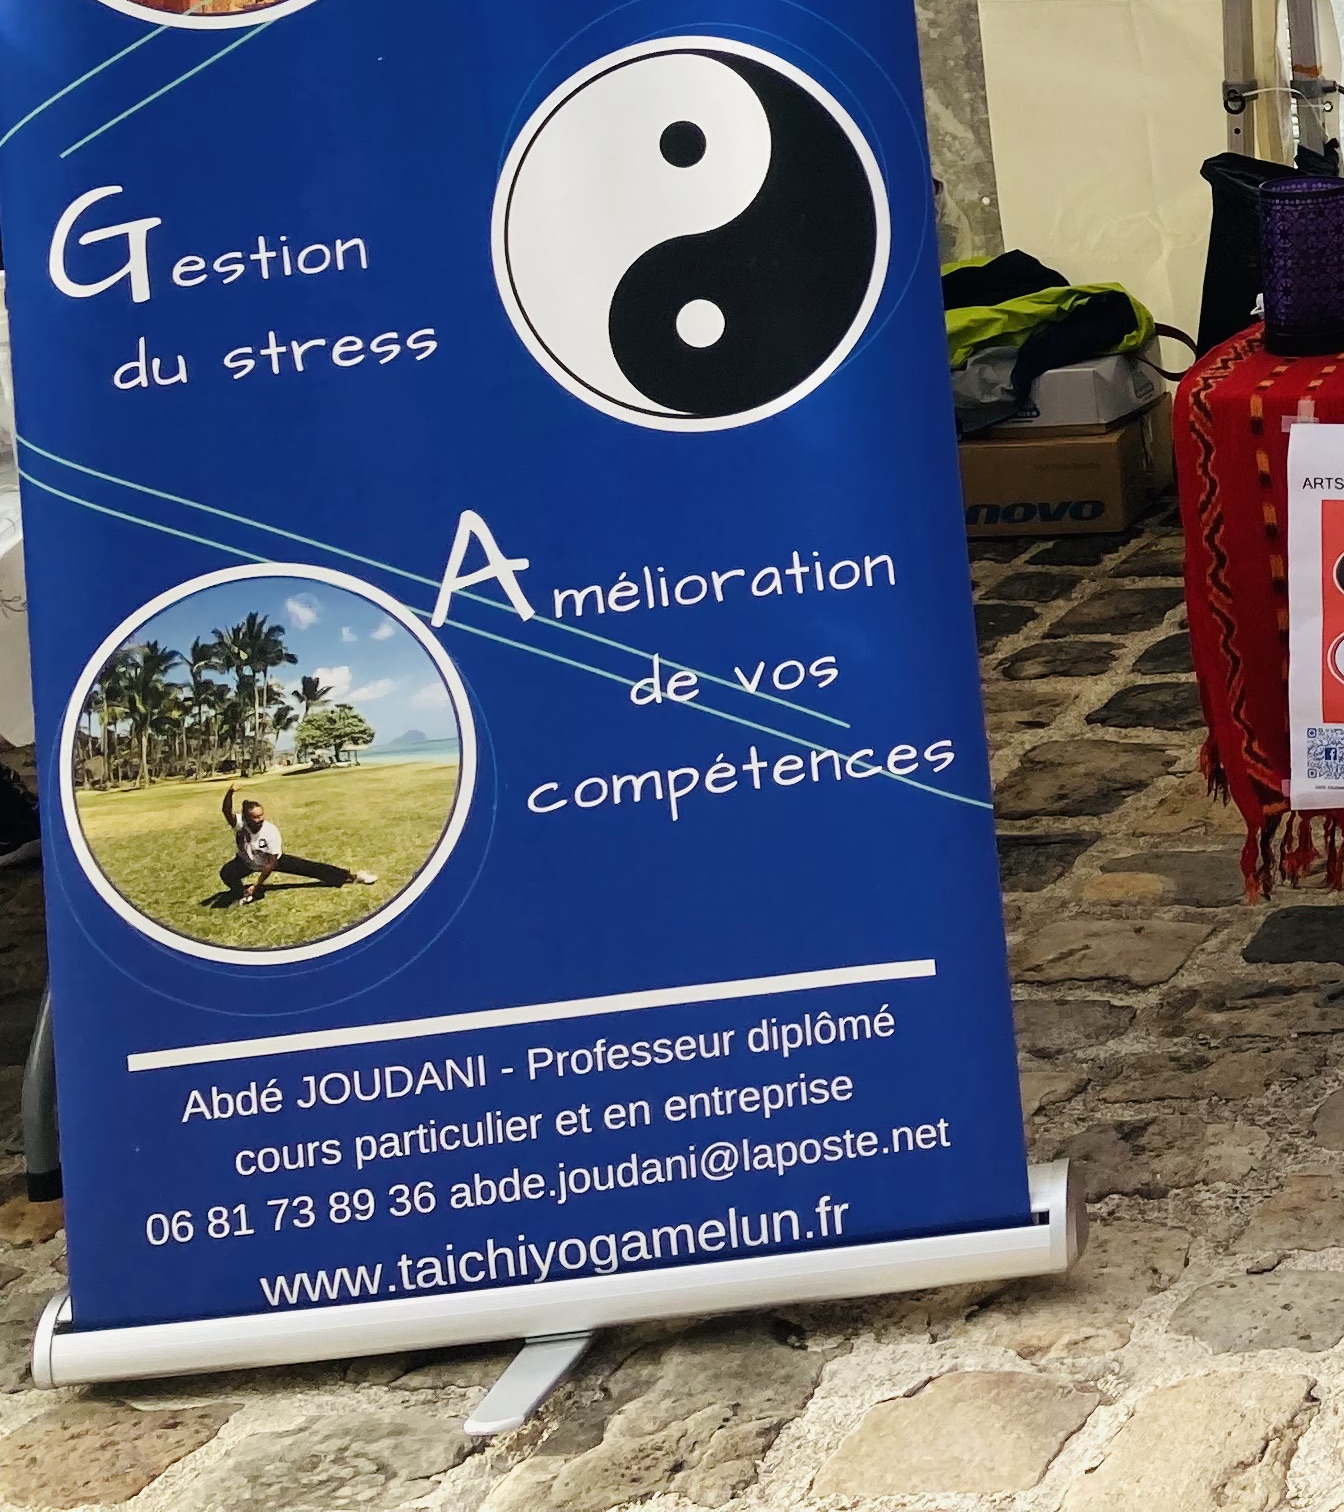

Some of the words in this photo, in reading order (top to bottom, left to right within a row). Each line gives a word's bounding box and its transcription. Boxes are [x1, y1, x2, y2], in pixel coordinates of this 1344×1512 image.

[48, 185, 368, 303] Gestion
[113, 336, 188, 390] du
[223, 325, 438, 377] stress
[1302, 477, 1344, 489] ARTS
[432, 510, 895, 629] Amélioration
[630, 654, 699, 707] de
[734, 652, 839, 696] vos
[527, 739, 956, 821] compétences
[181, 1077, 284, 1122] Abdé
[295, 1053, 488, 1110] JOUDANI
[499, 1065, 514, 1074] -
[527, 1026, 735, 1082] Professeur
[747, 1004, 896, 1057] diplômé
[234, 1137, 342, 1177] cours
[354, 1110, 541, 1171] particulier
[555, 1102, 592, 1136] et
[603, 1096, 652, 1130] en
[663, 1071, 855, 1132] entreprise
[145, 1212, 195, 1247] 06
[206, 1204, 255, 1241] 81
[267, 1196, 316, 1232] 73
[327, 1188, 377, 1224] 89
[388, 1180, 437, 1216] 36
[448, 1118, 952, 1210] abde.joudani@laposte.net
[259, 1195, 850, 1309] www.taichiyogamelun.fr
